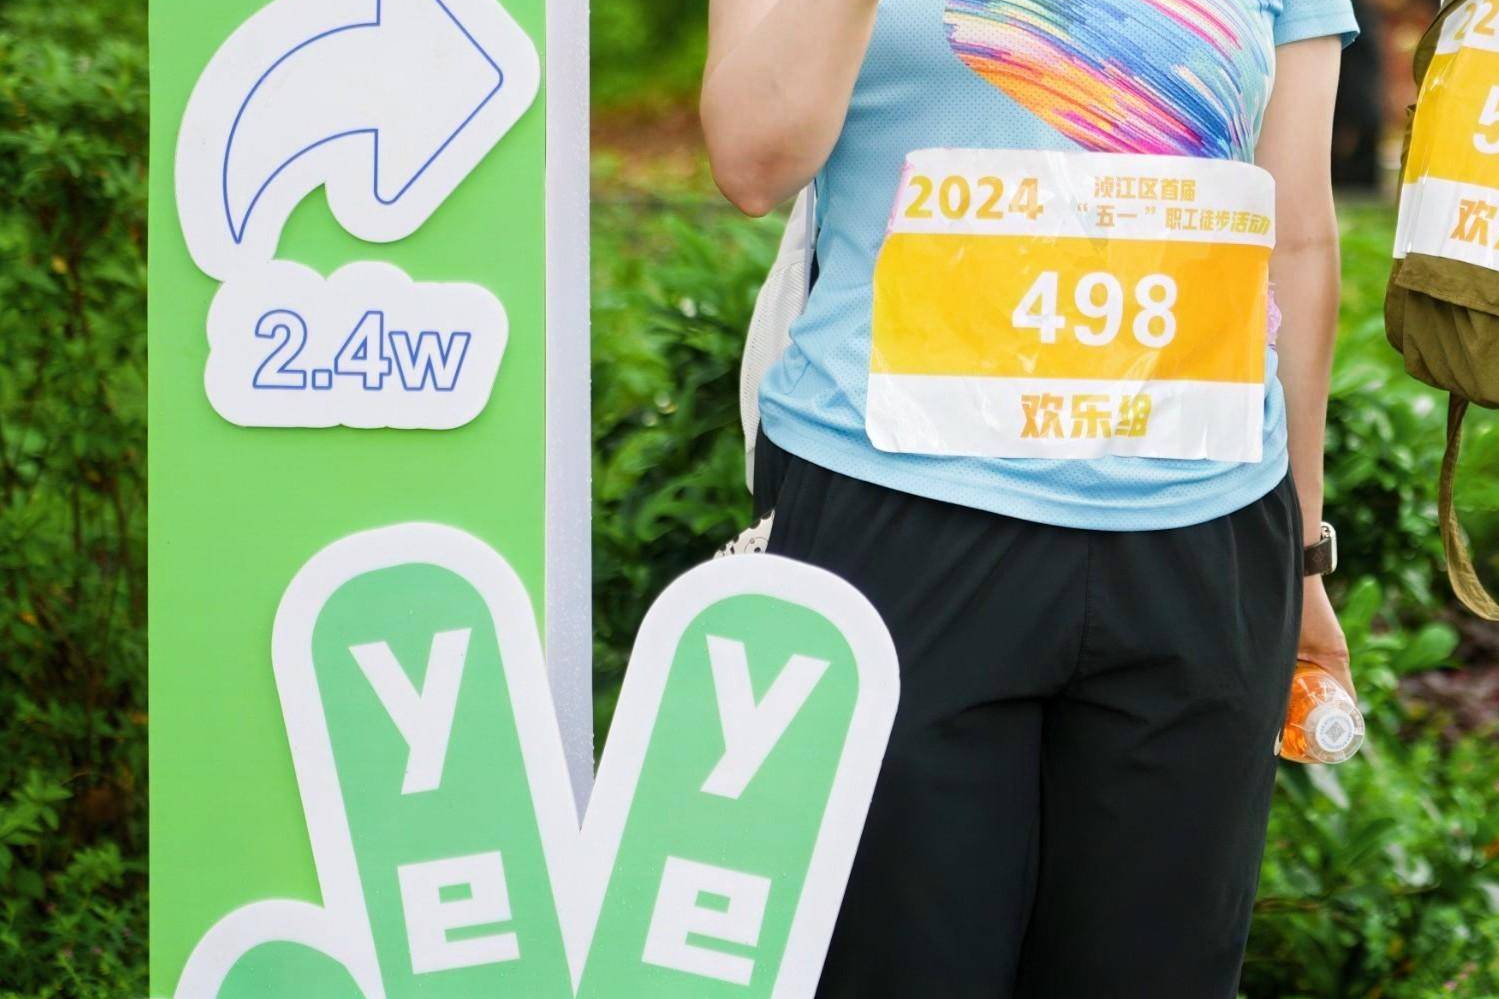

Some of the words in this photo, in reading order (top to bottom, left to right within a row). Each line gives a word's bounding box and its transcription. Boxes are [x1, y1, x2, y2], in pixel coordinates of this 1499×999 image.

[904, 175, 1044, 220] 2024
[1093, 175, 1196, 202] 浈江区首届
[1012, 271, 1178, 348] 498
[252, 308, 471, 391] 2.4w
[1020, 393, 1152, 439] 欢乐组
